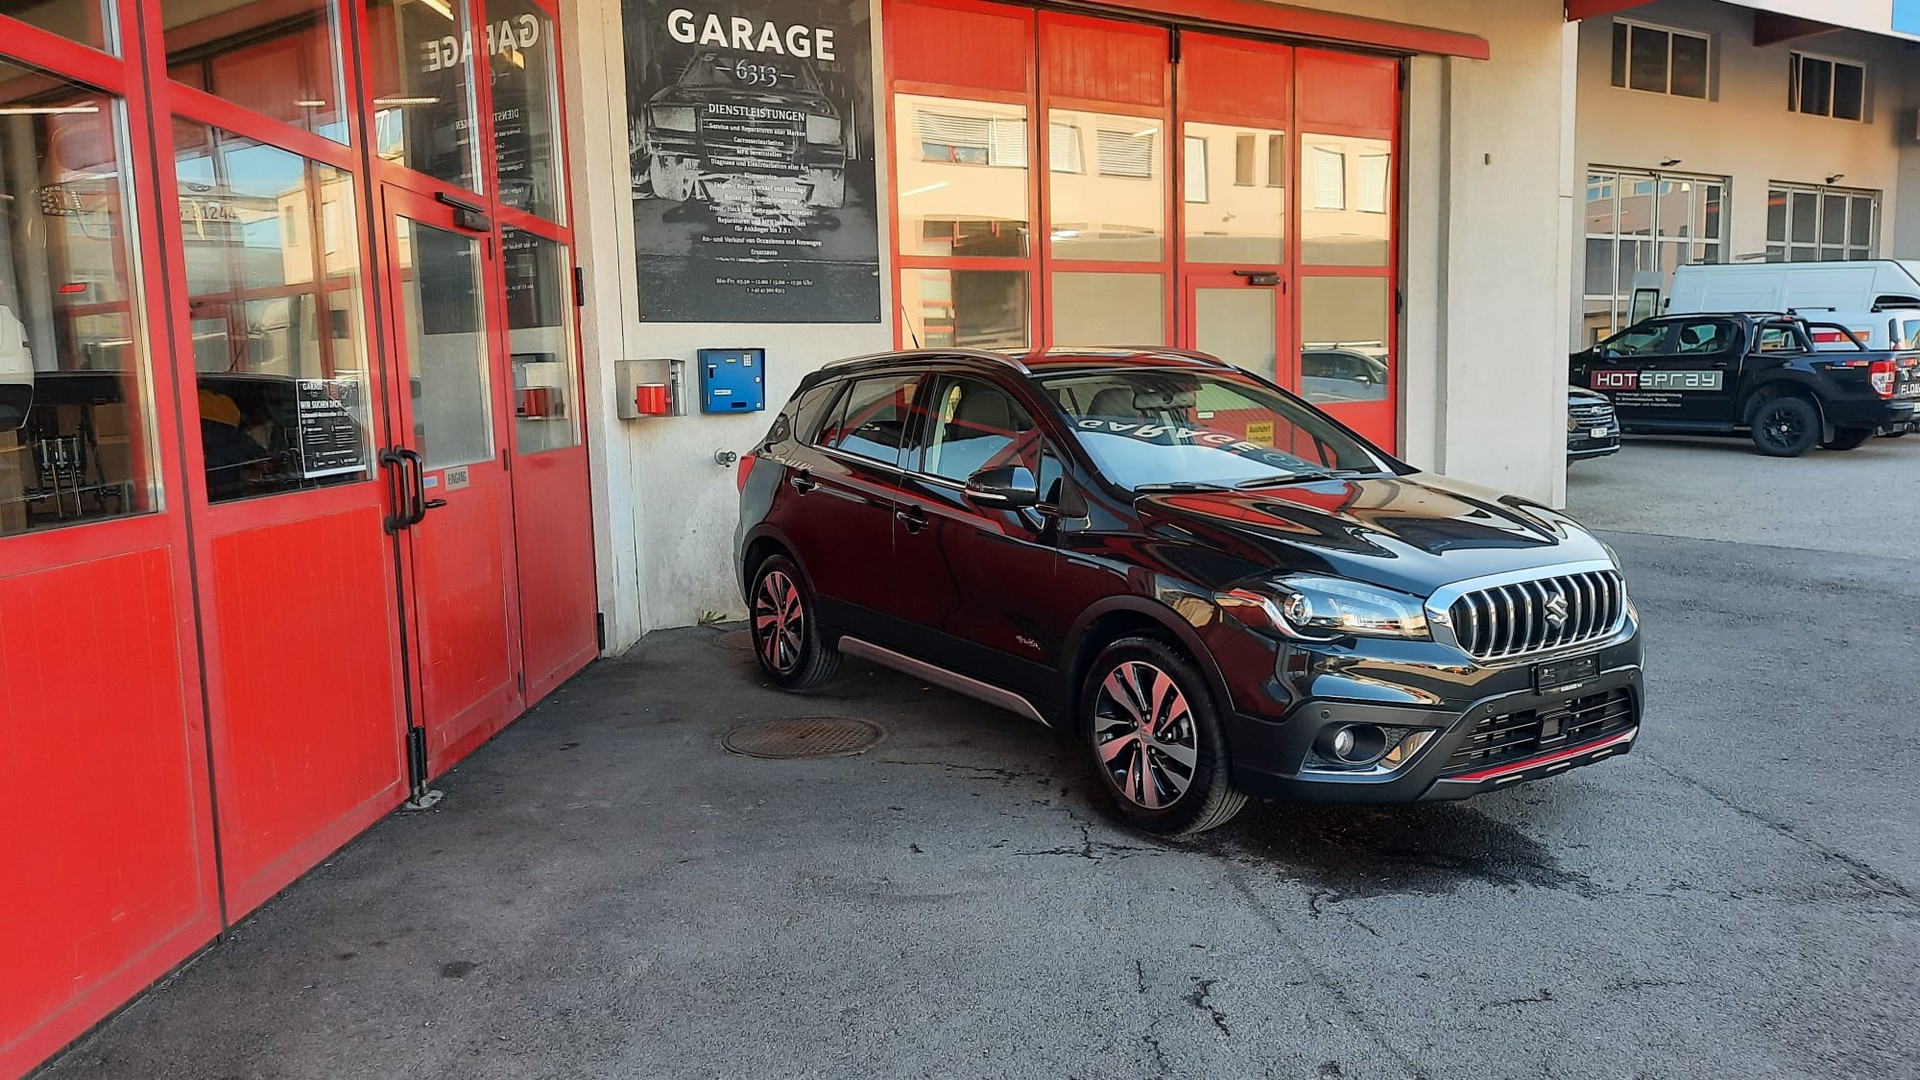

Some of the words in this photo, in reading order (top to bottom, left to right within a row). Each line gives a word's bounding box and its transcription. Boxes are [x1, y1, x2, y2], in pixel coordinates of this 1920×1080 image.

[667, 8, 836, 62] GARAGE
[736, 58, 778, 87] 6313
[708, 103, 806, 122] DIENSTLEISTUNGEN
[730, 124, 740, 132] und
[736, 159, 746, 167] und
[713, 235, 723, 243] und
